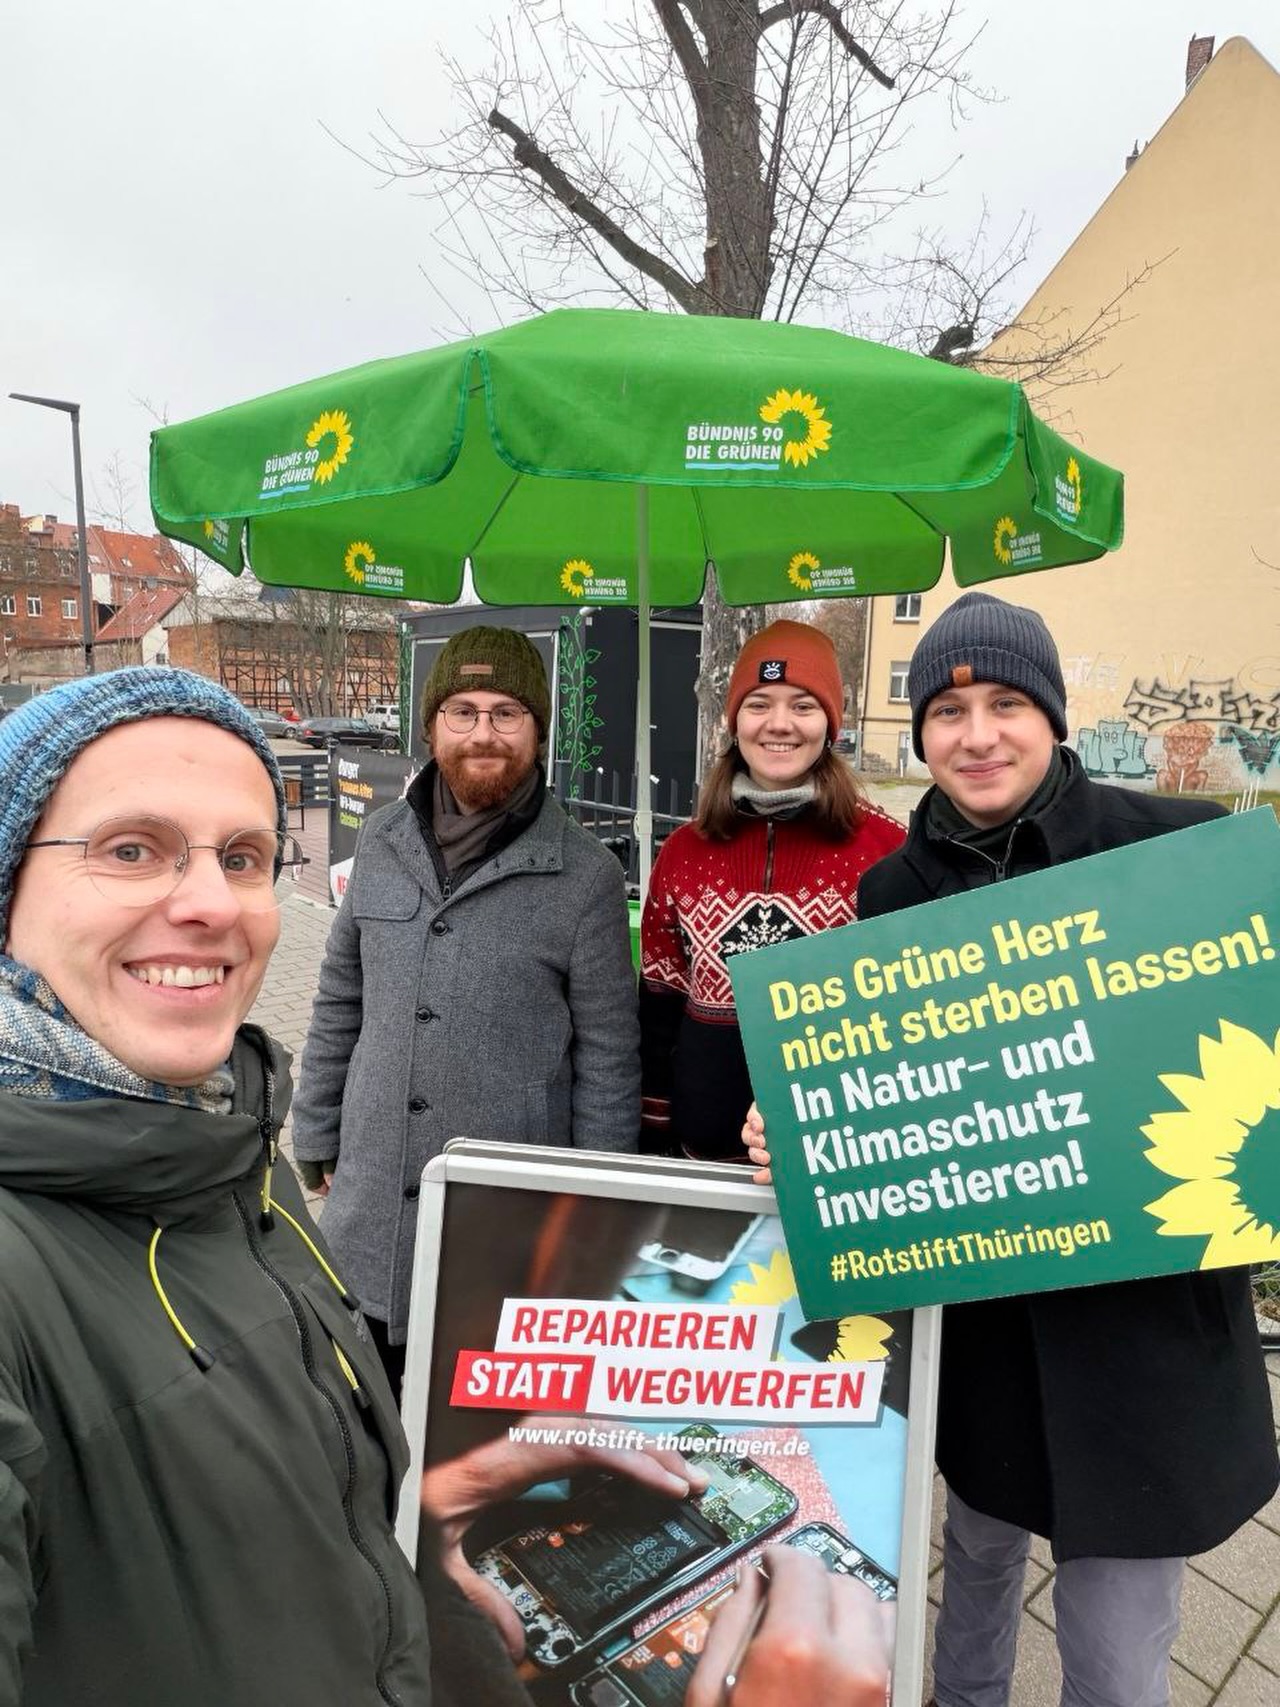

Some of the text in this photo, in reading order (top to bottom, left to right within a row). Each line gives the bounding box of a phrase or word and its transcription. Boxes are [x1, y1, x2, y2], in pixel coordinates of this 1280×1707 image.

[304, 449, 320, 464] 90
[685, 421, 784, 442] BÜNDNIS 90
[685, 441, 782, 461] DIE GRÜNEN
[768, 909, 1108, 1022] Das Grüne Herz
[780, 914, 1277, 1072] nicht sterben lassen!
[789, 1019, 1096, 1123] In Natur- und
[801, 1090, 1092, 1176] Klimaschutz
[813, 1140, 1090, 1228] investieren!
[829, 1217, 1112, 1283] #RotstiftThüringen
[511, 1306, 759, 1351] REPARIEREN
[466, 1358, 866, 1411] STATT WEGWERFEN
[508, 1424, 812, 1458] www.rotstift-thueringen.de
